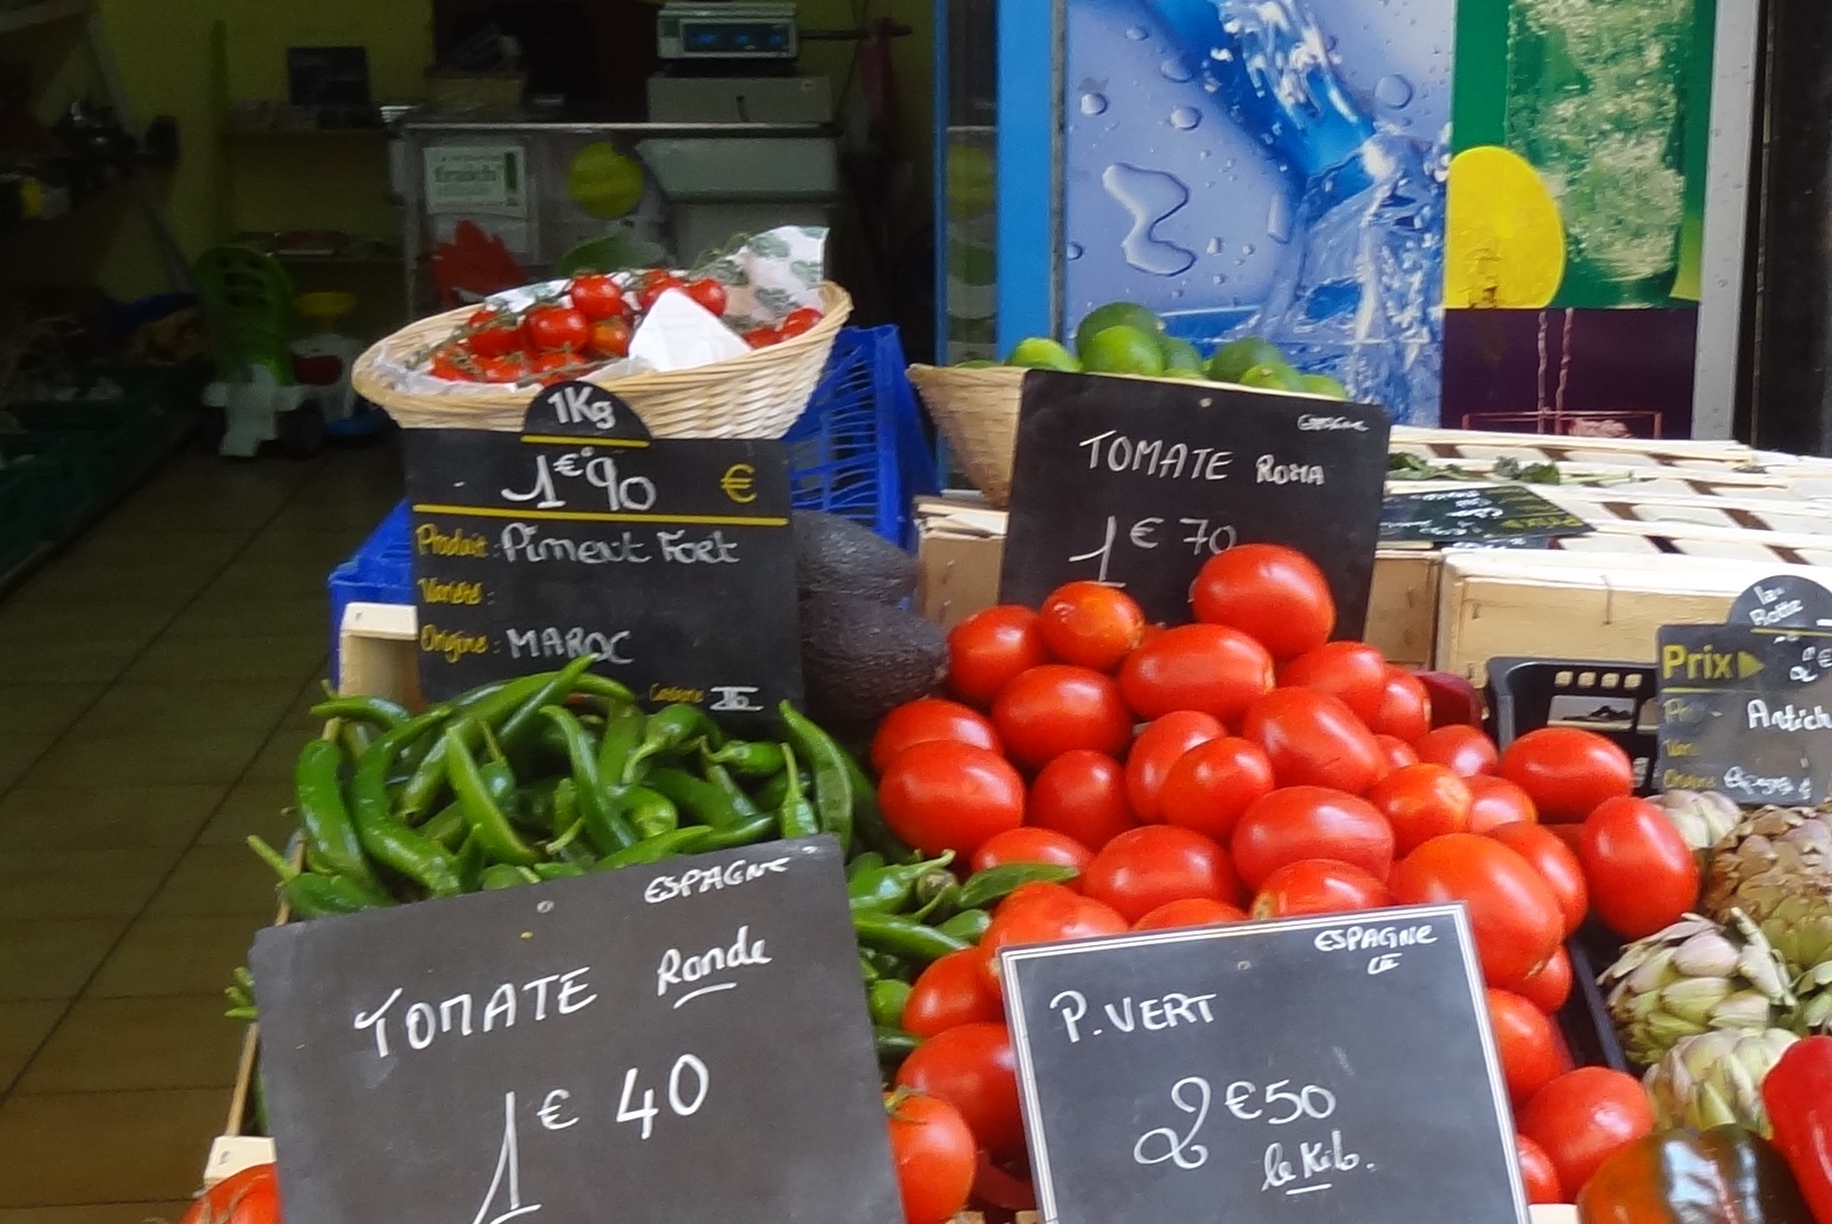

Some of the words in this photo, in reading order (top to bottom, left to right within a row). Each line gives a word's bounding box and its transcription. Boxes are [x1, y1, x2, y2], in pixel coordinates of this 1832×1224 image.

[547, 387, 618, 429] 1Kg
[1078, 430, 1235, 481] TOMATE
[500, 521, 654, 564] Piment
[657, 529, 742, 564] Fort
[506, 627, 636, 665] MAROC
[1661, 643, 1735, 681] Prix
[1314, 923, 1439, 952] ESPAGNE
[353, 967, 599, 1060] TOMATE
